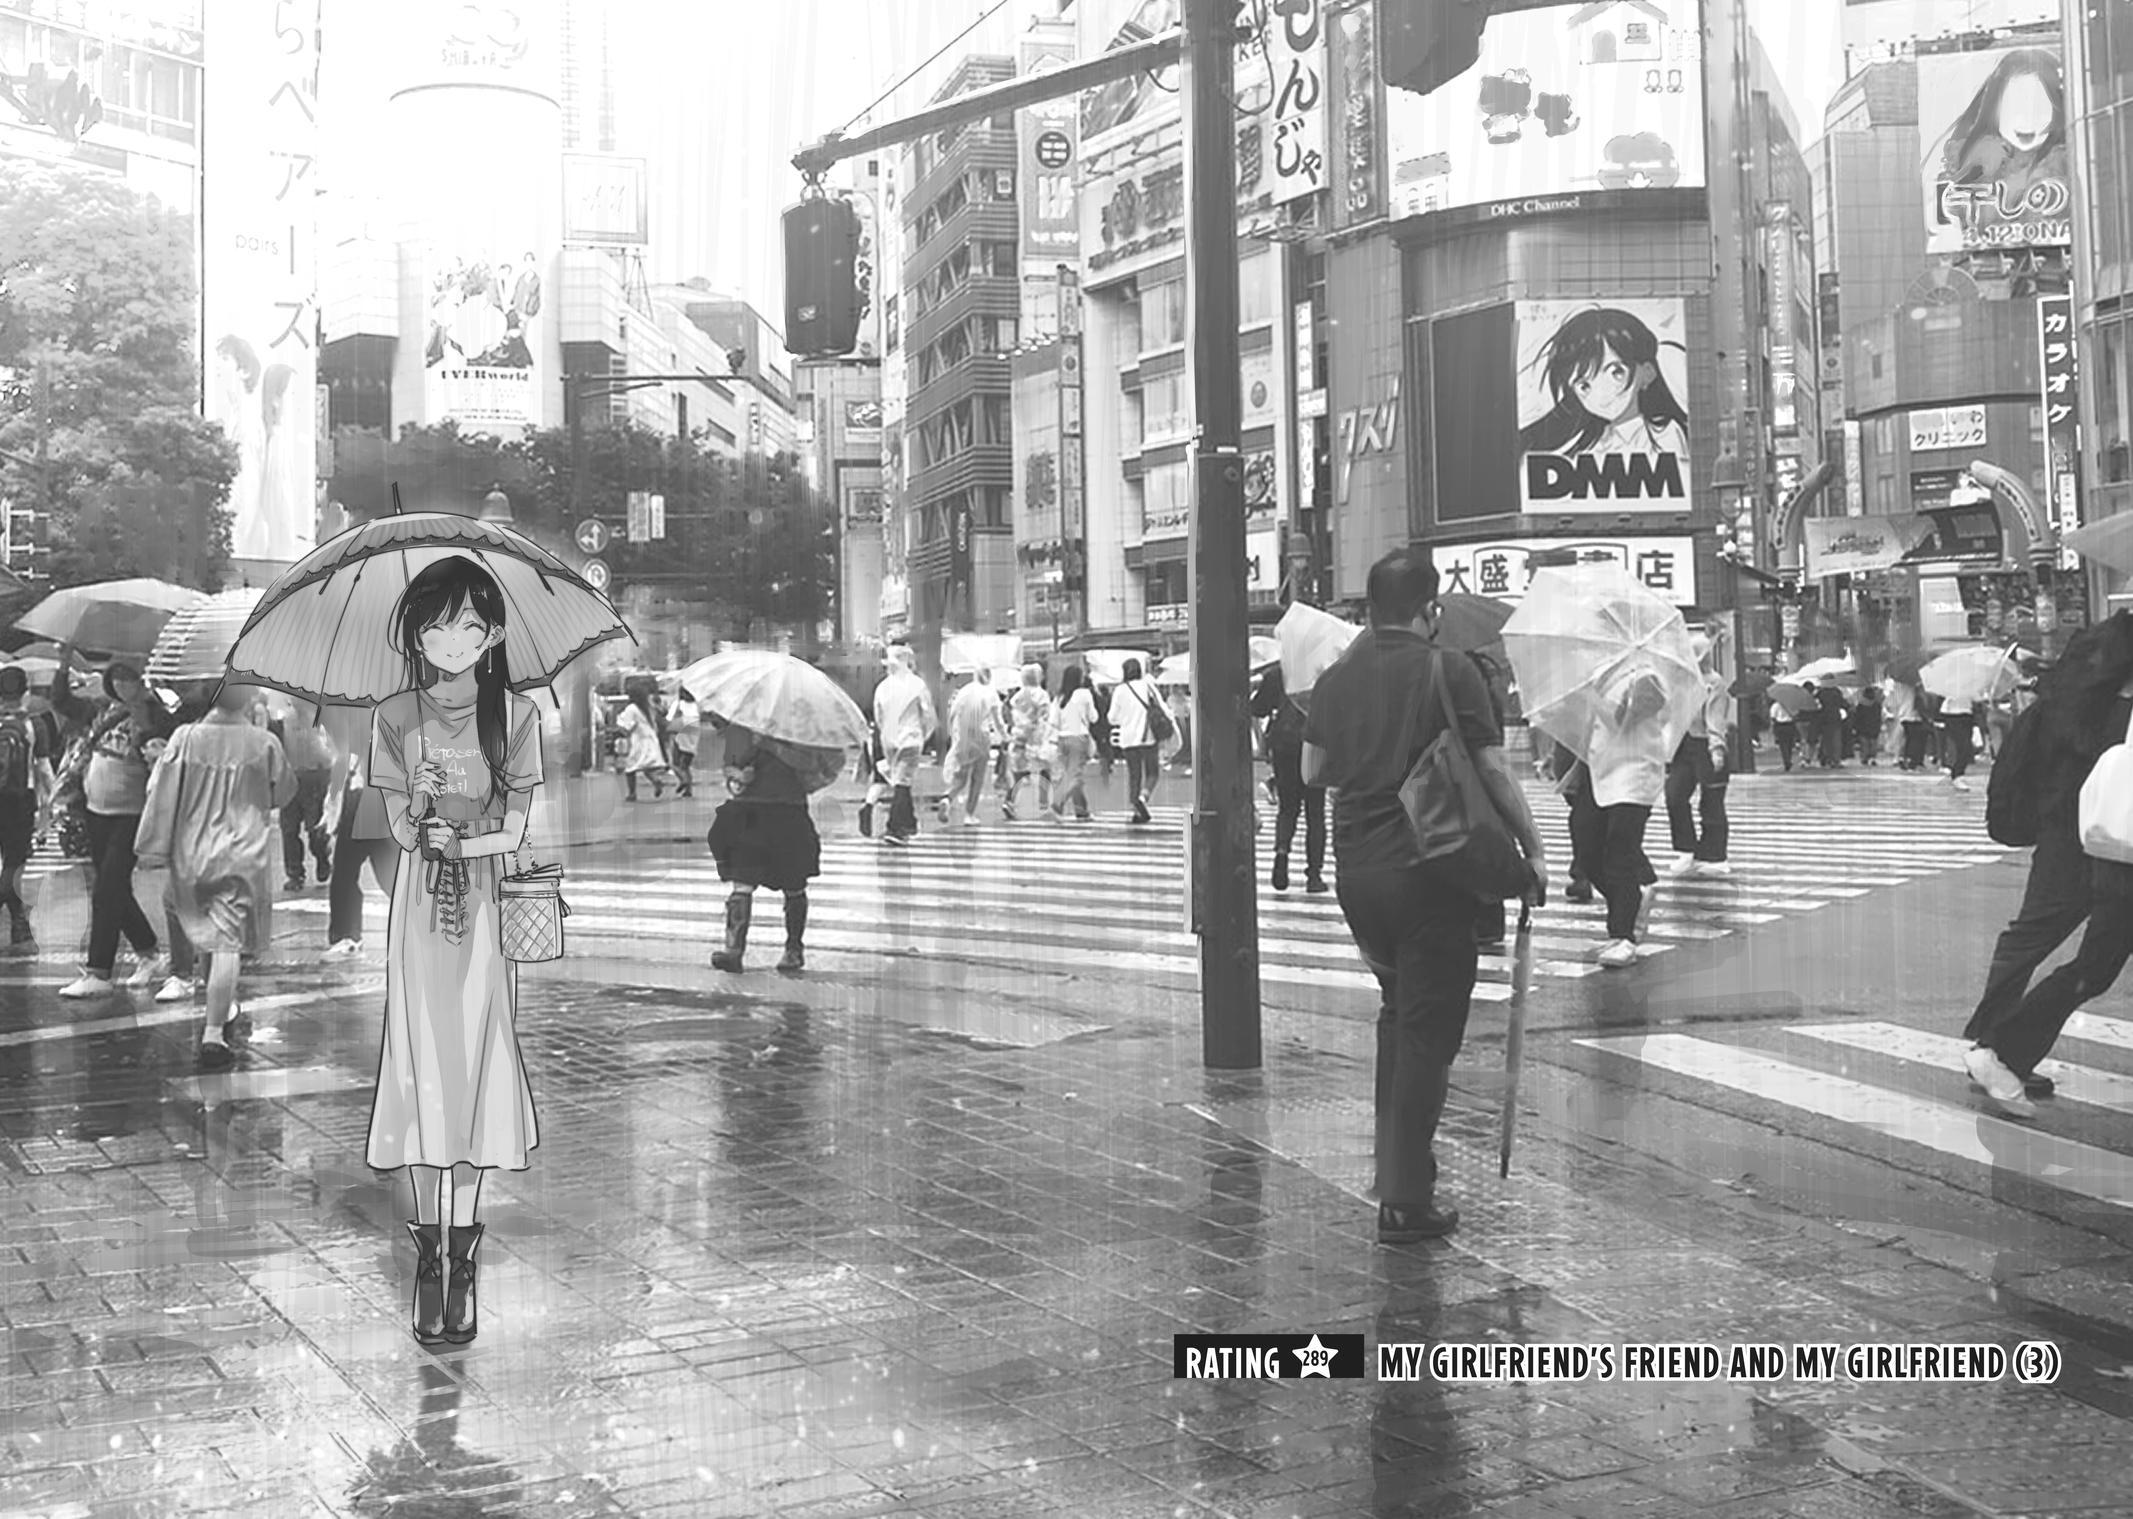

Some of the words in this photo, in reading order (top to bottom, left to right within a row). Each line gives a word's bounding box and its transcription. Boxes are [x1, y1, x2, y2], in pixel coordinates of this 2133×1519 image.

[1490, 203, 1521, 217] DHC
[1524, 195, 1581, 212] Channel
[2045, 313, 2072, 423] カラオケ
[1914, 428, 1984, 447] クリニック
[1527, 452, 1684, 500] DMM
